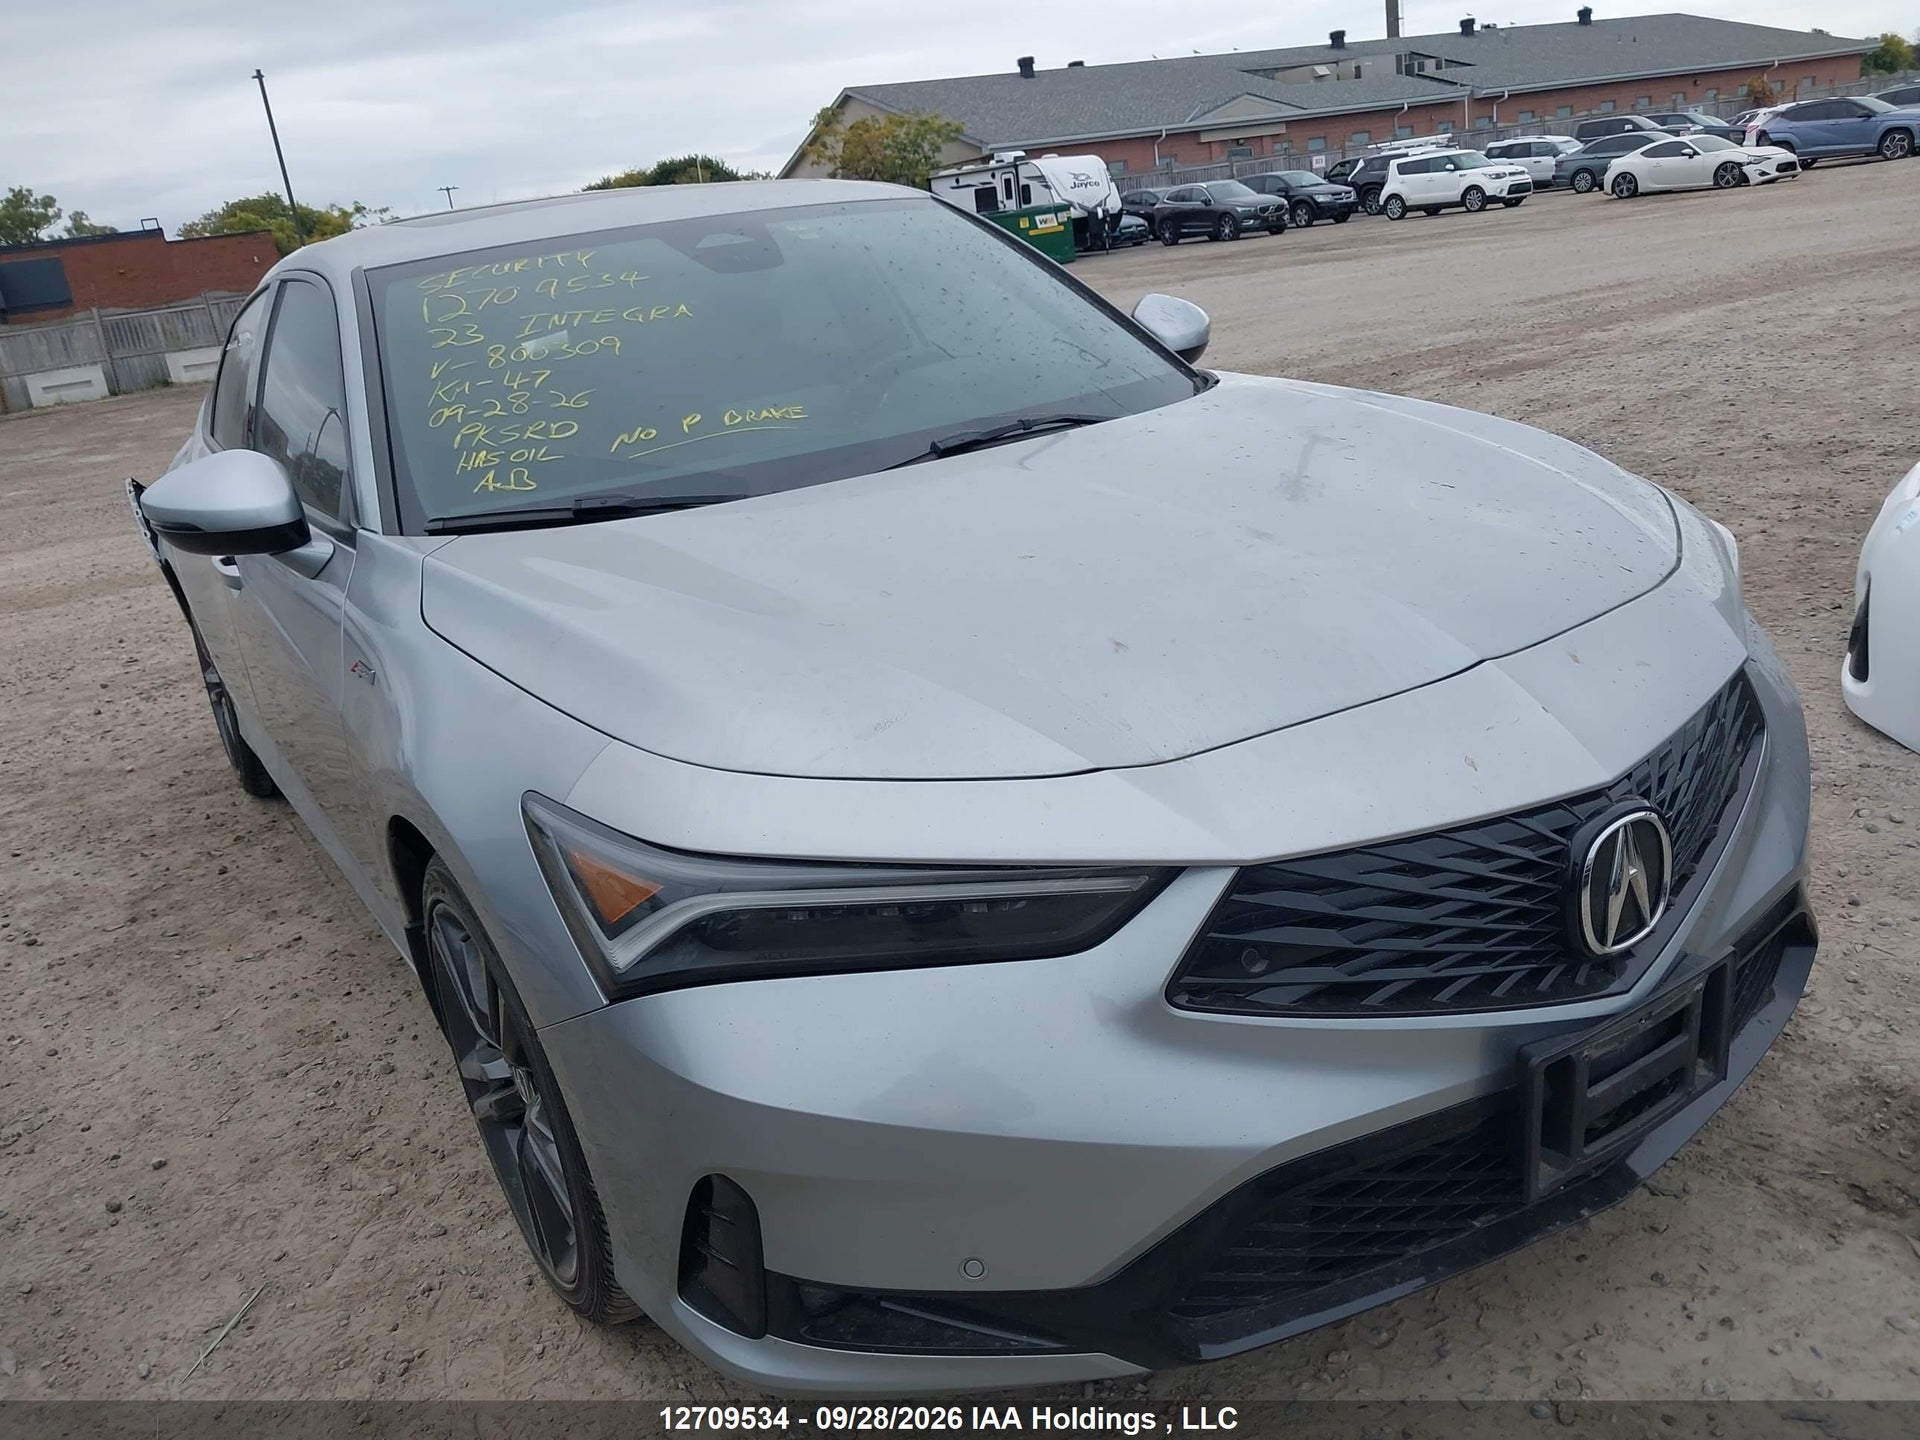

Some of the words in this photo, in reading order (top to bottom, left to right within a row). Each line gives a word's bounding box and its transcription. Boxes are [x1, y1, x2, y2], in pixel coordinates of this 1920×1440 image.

[417, 251, 596, 295] SECURITY
[428, 324, 484, 348] 23
[515, 304, 694, 339] INTEGRA
[429, 389, 597, 427] 09-28-26
[611, 426, 656, 452] NO
[682, 413, 701, 433] P
[724, 405, 808, 426] BRAKE
[456, 450, 505, 475] HAS
[510, 446, 565, 463] OIL
